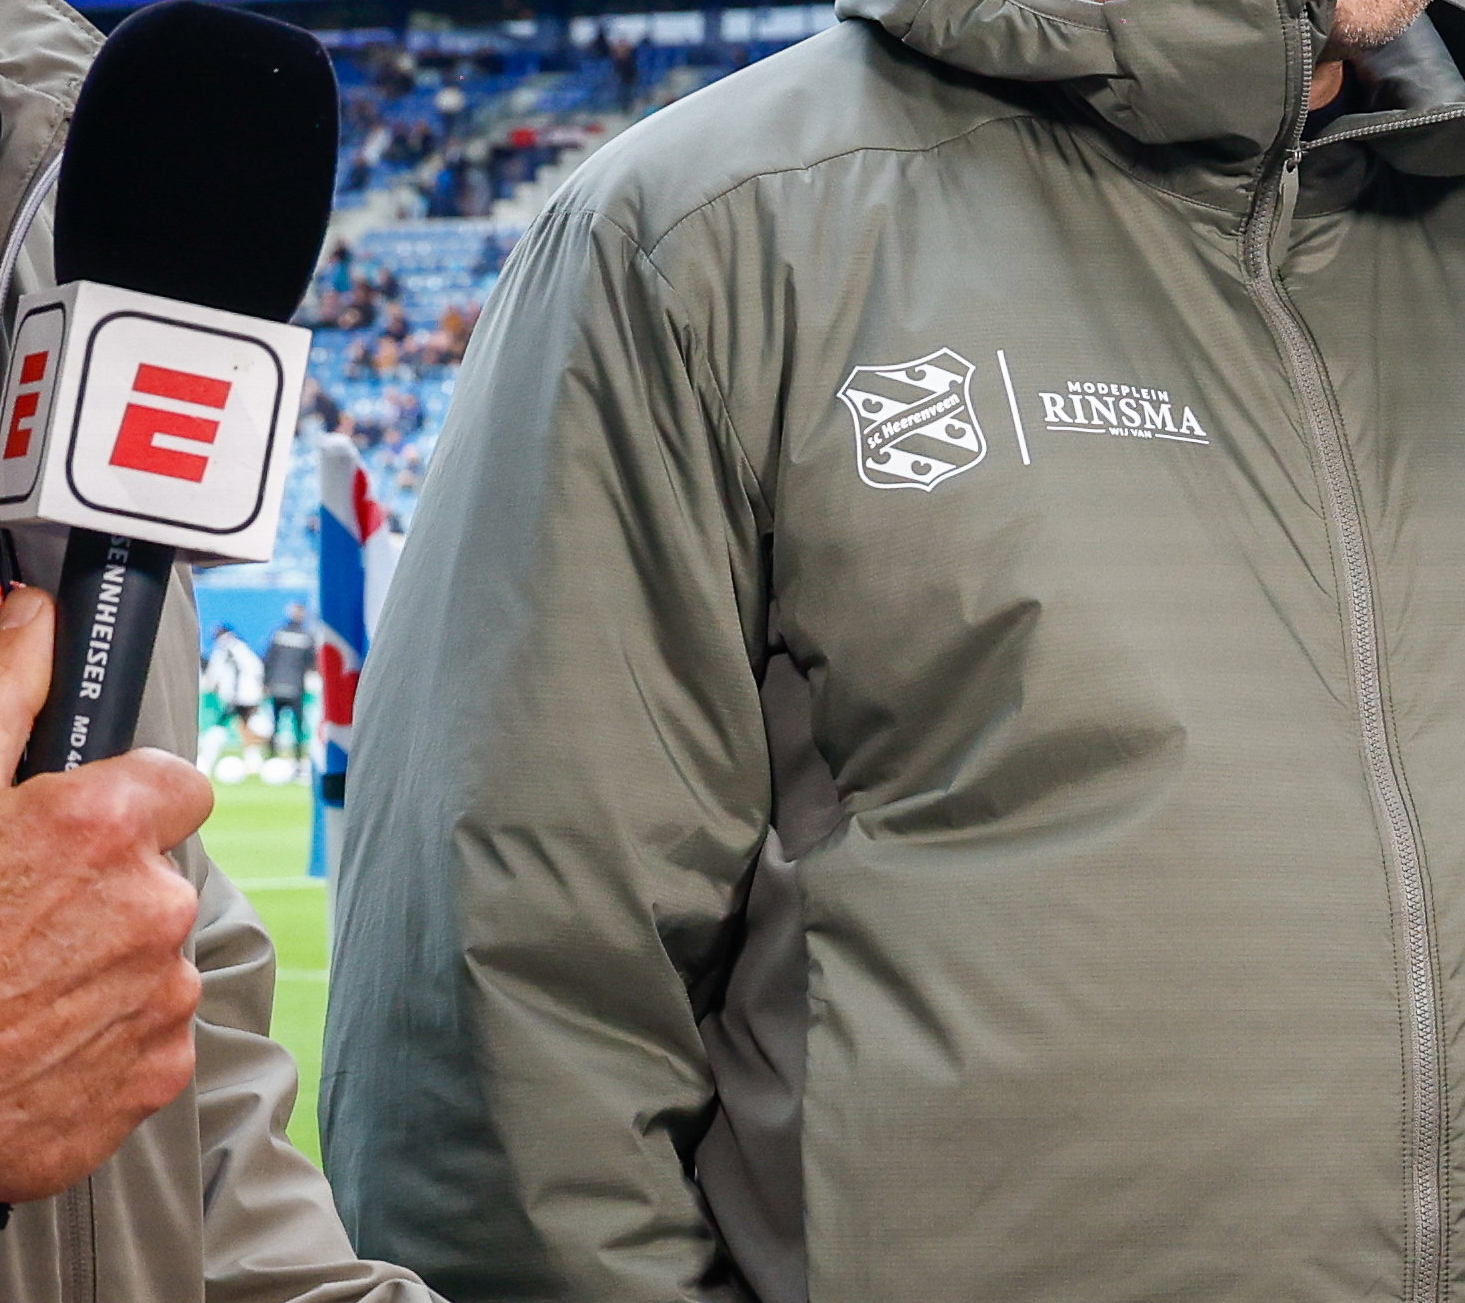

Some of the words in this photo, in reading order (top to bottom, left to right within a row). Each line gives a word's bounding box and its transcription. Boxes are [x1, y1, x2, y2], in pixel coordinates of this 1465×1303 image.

[1067, 380, 1169, 402] MODEPLEIN
[108, 362, 233, 483] E
[867, 433, 883, 449] sc
[882, 393, 961, 438] Heerenveen
[1039, 392, 1207, 437] RINSMA
[1109, 427, 1129, 438] WIJ
[1129, 428, 1153, 439] VAN
[79, 533, 132, 700] SENNHEISER
[70, 714, 91, 748] MD
